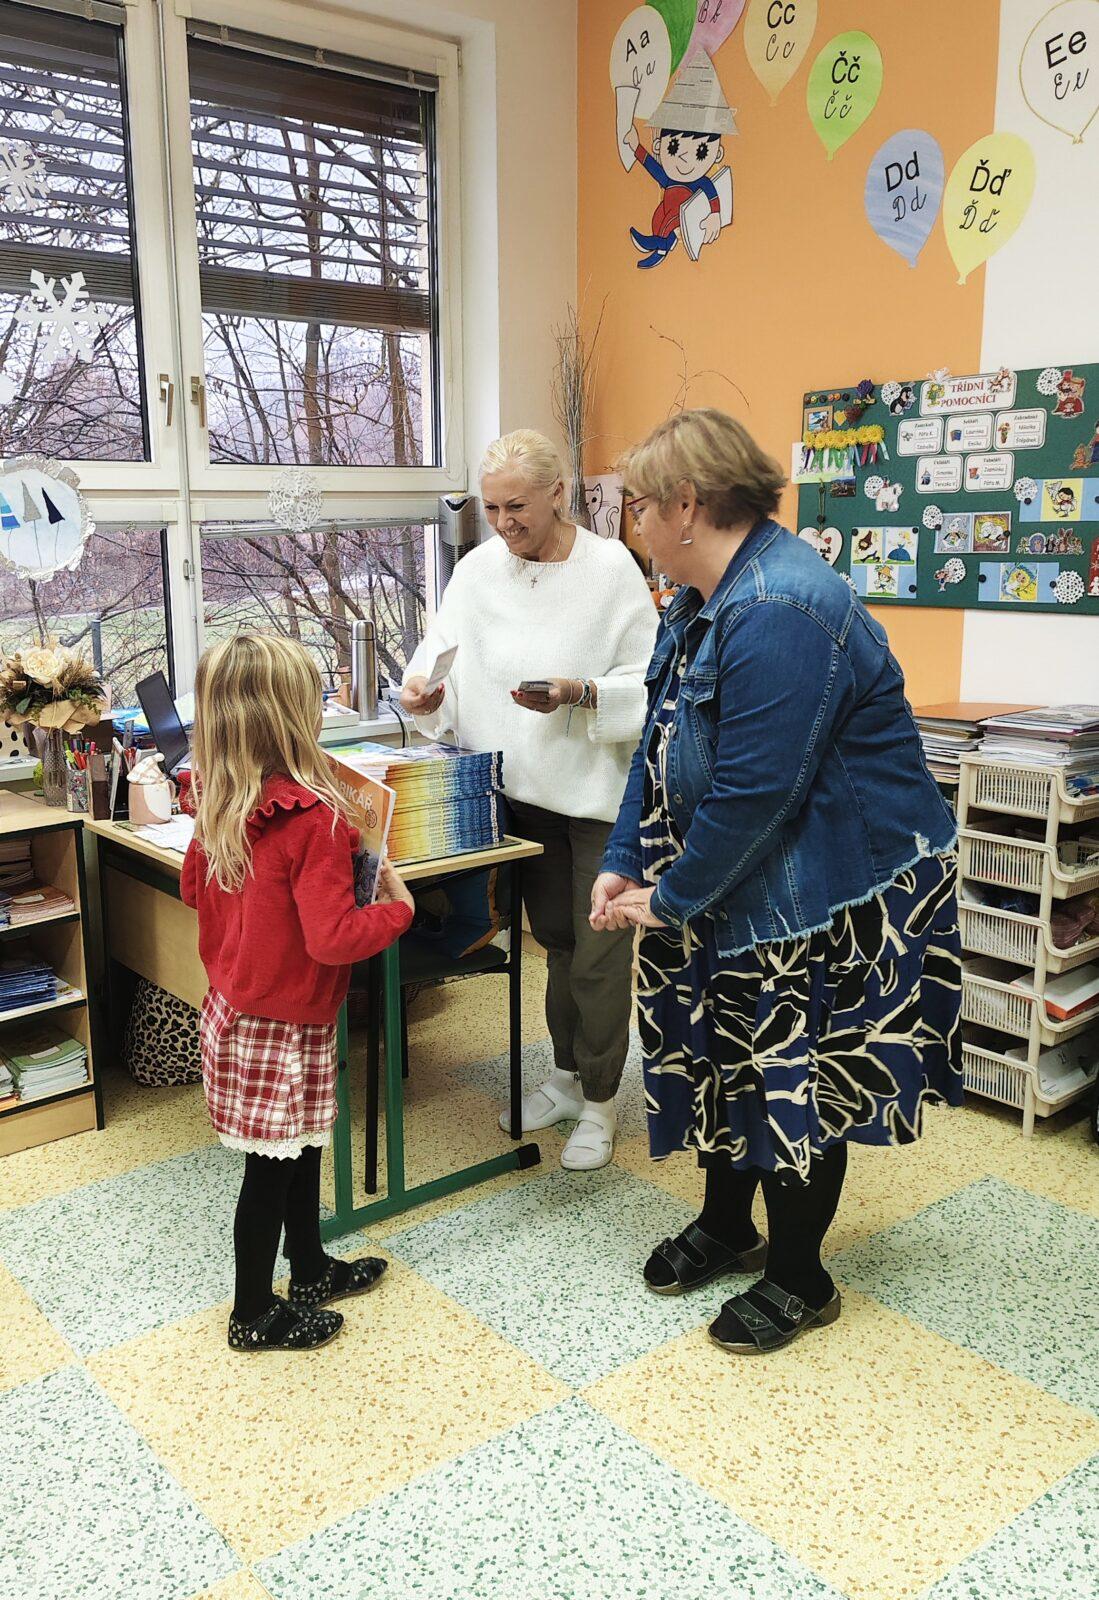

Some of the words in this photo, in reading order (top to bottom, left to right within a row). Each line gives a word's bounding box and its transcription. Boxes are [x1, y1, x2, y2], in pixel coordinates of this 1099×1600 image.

[767, 0, 796, 29] Cc
[1045, 30, 1087, 69] Ee
[831, 51, 861, 84] Čč
[884, 151, 920, 192] Dd
[941, 394, 996, 407] POMOCNÍCI
[951, 381, 984, 393] TŘÍDNÍ
[339, 781, 373, 811] BIKÁŘ
